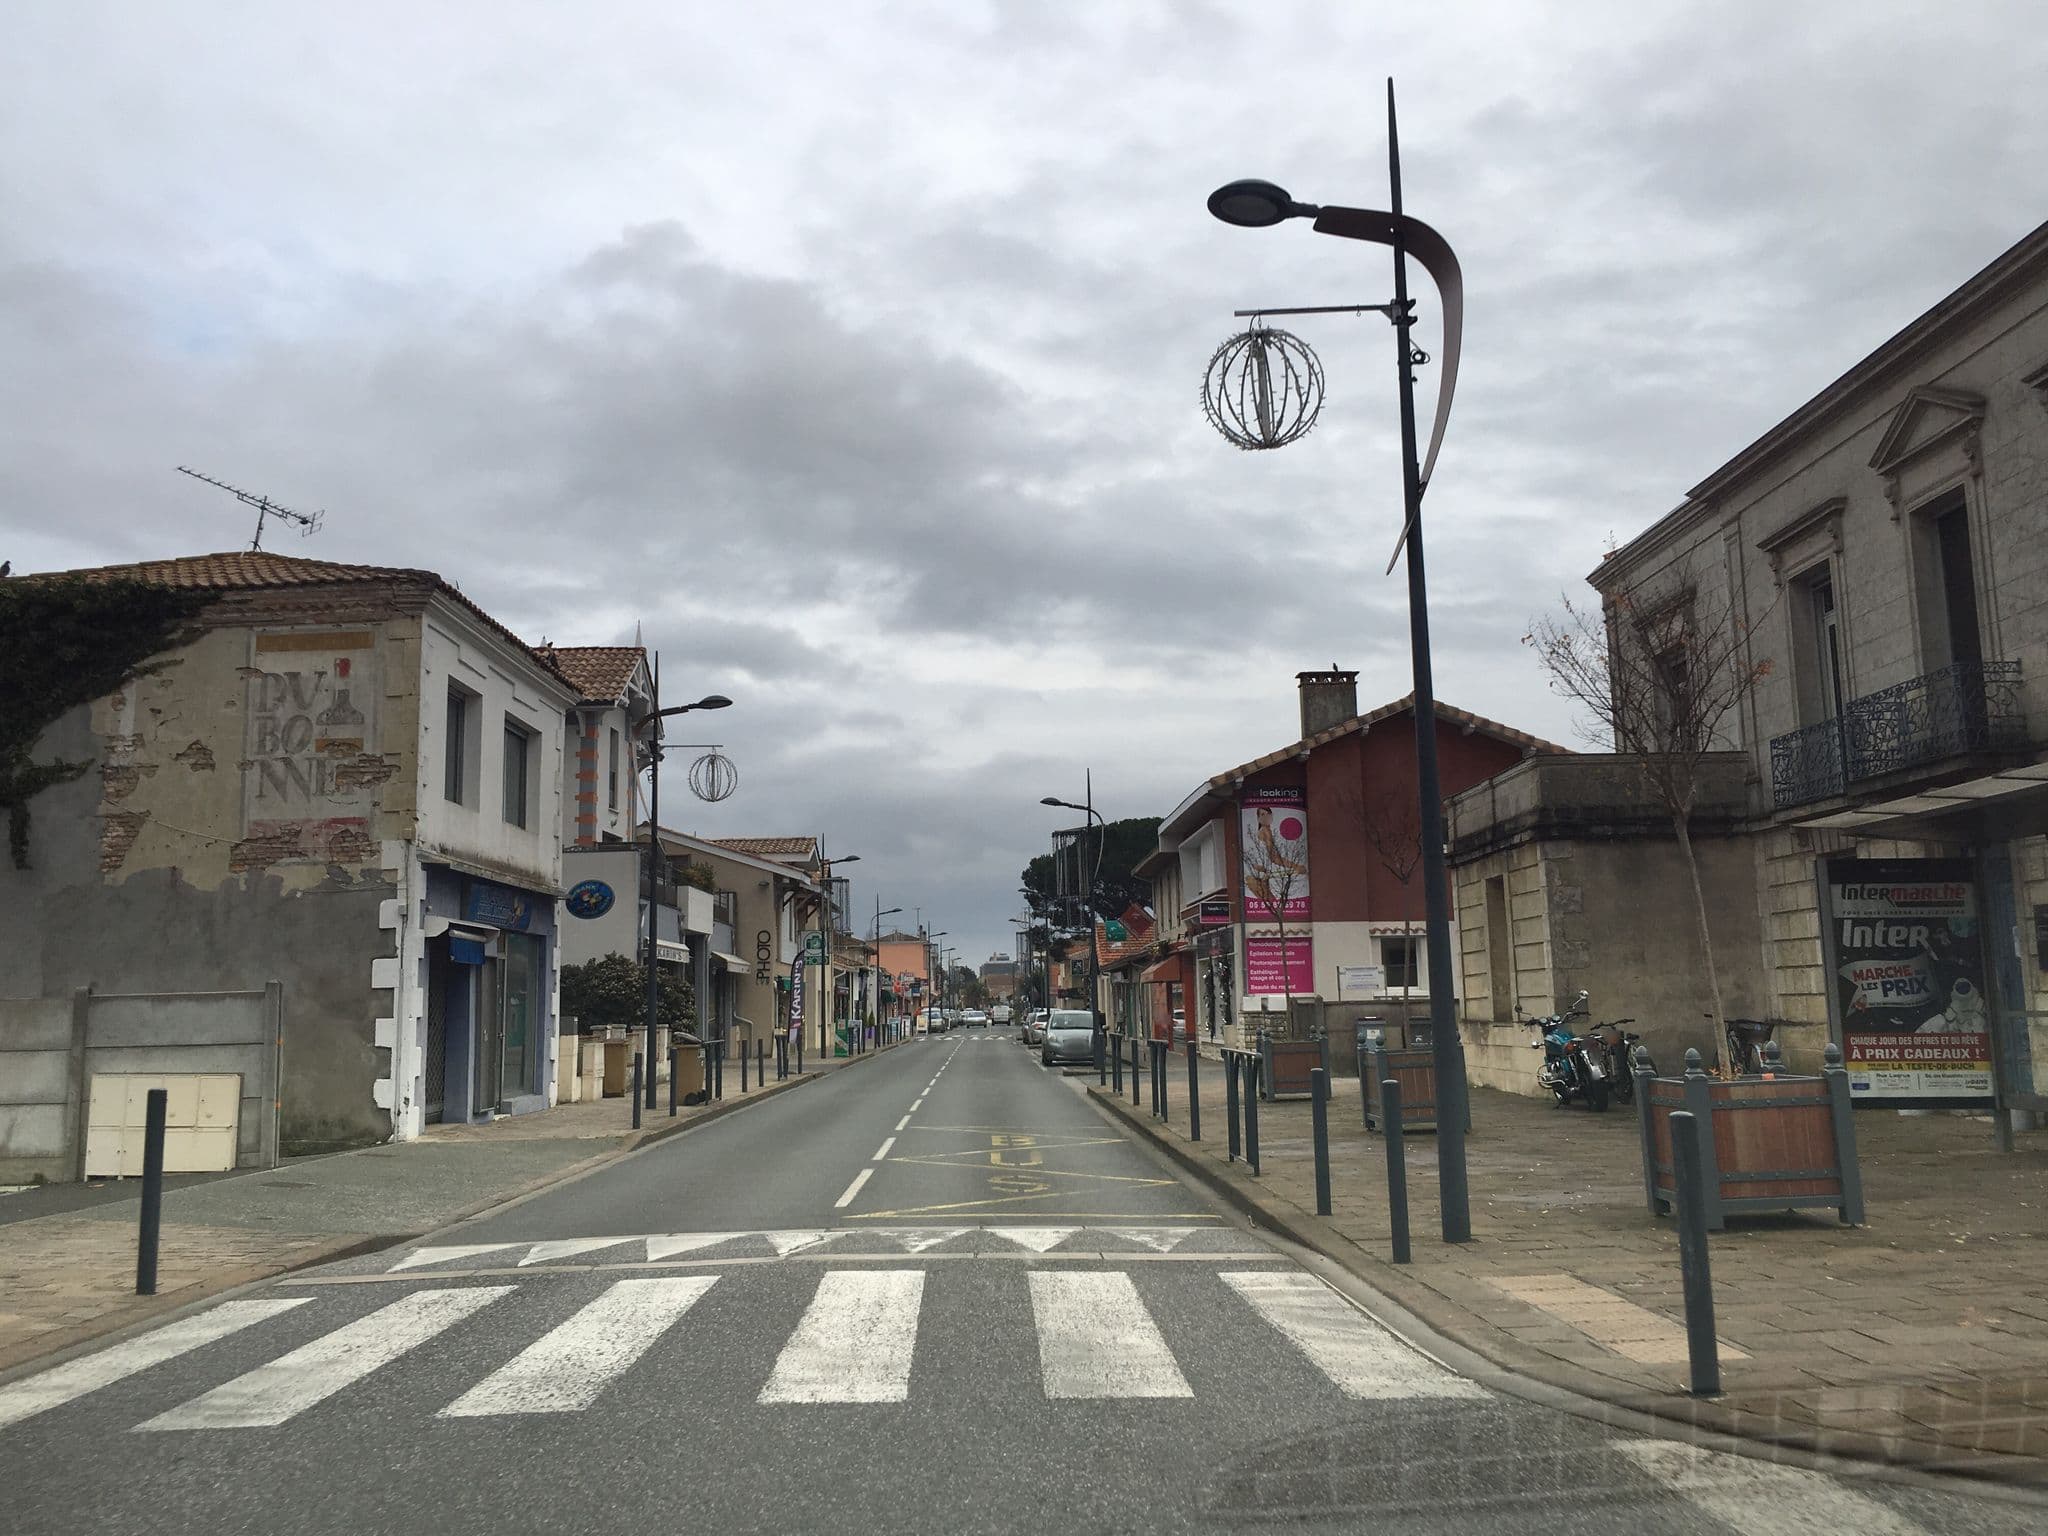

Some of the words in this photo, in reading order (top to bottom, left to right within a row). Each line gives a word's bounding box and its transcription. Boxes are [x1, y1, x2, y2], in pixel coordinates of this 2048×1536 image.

[1259, 788, 1299, 799] looking
[757, 930, 771, 980] PHOTO
[1852, 965, 1914, 982] MARCHE
[1861, 982, 1879, 992] LES
[1882, 975, 1931, 998] PRIX
[1850, 1036, 1878, 1046] CHAQUE
[1878, 1036, 1897, 1046] JOUR
[1898, 1036, 1913, 1046] DES
[1941, 1036, 1950, 1045] ET
[1852, 1046, 1862, 1059] À
[1865, 1048, 1900, 1059] PRIX
[1904, 1048, 1970, 1060] CADEAUX
